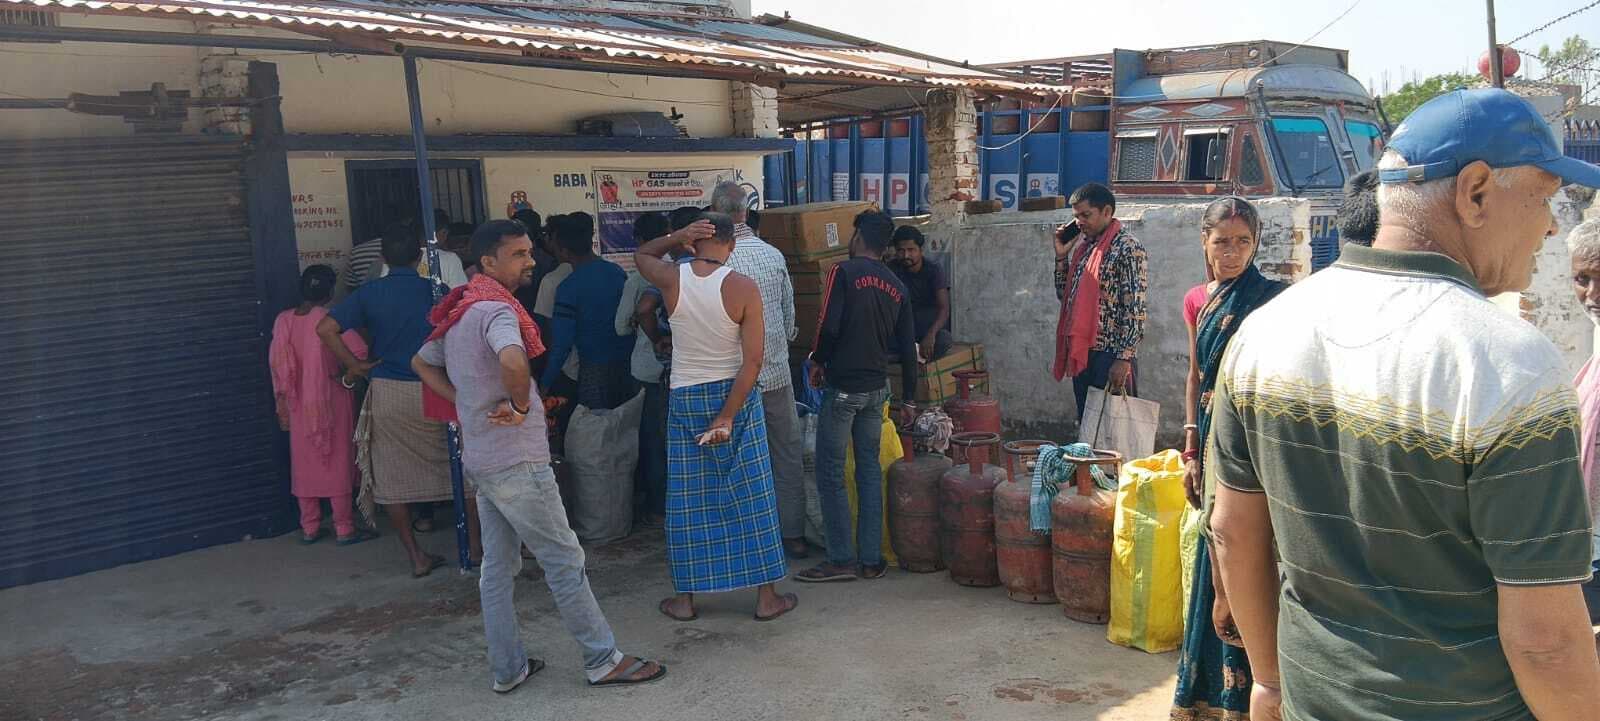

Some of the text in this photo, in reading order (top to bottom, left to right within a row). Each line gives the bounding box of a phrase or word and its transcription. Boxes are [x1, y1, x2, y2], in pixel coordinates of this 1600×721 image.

[554, 173, 587, 188] BABA
[631, 180, 645, 188] HP
[855, 275, 902, 304] COMMANDO
